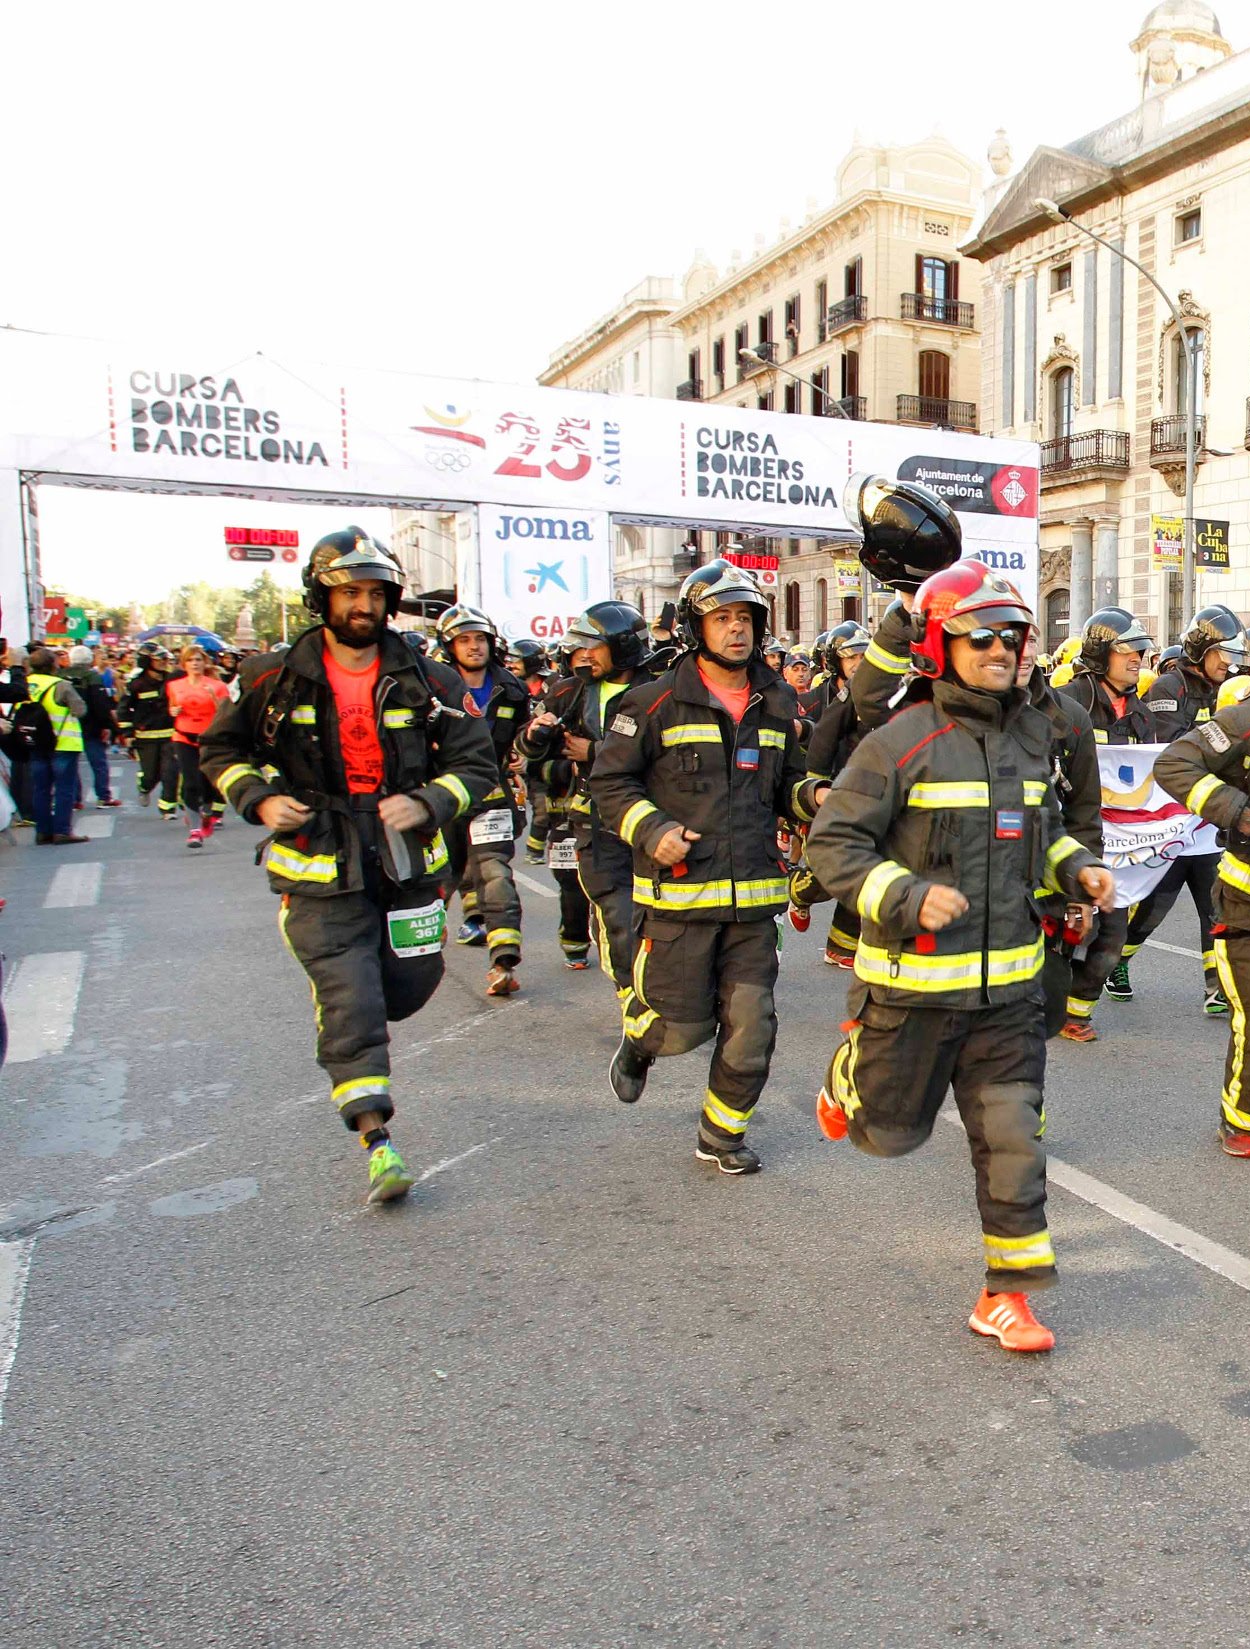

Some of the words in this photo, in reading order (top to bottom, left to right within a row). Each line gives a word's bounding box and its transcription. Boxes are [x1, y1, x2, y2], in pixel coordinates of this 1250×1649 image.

[129, 370, 245, 404] CURSA
[130, 397, 281, 435] BOMBERS
[132, 426, 330, 467] BARCELONA
[597, 420, 621, 486] anys
[696, 427, 779, 456] CURSA
[697, 450, 804, 481] BOMBERS
[915, 467, 971, 483] Ajuntament
[971, 473, 985, 484] de
[697, 475, 838, 509] BARCELONA
[1206, 523, 1223, 538] La
[409, 914, 440, 929] ALEIX
[415, 926, 439, 939] 367
